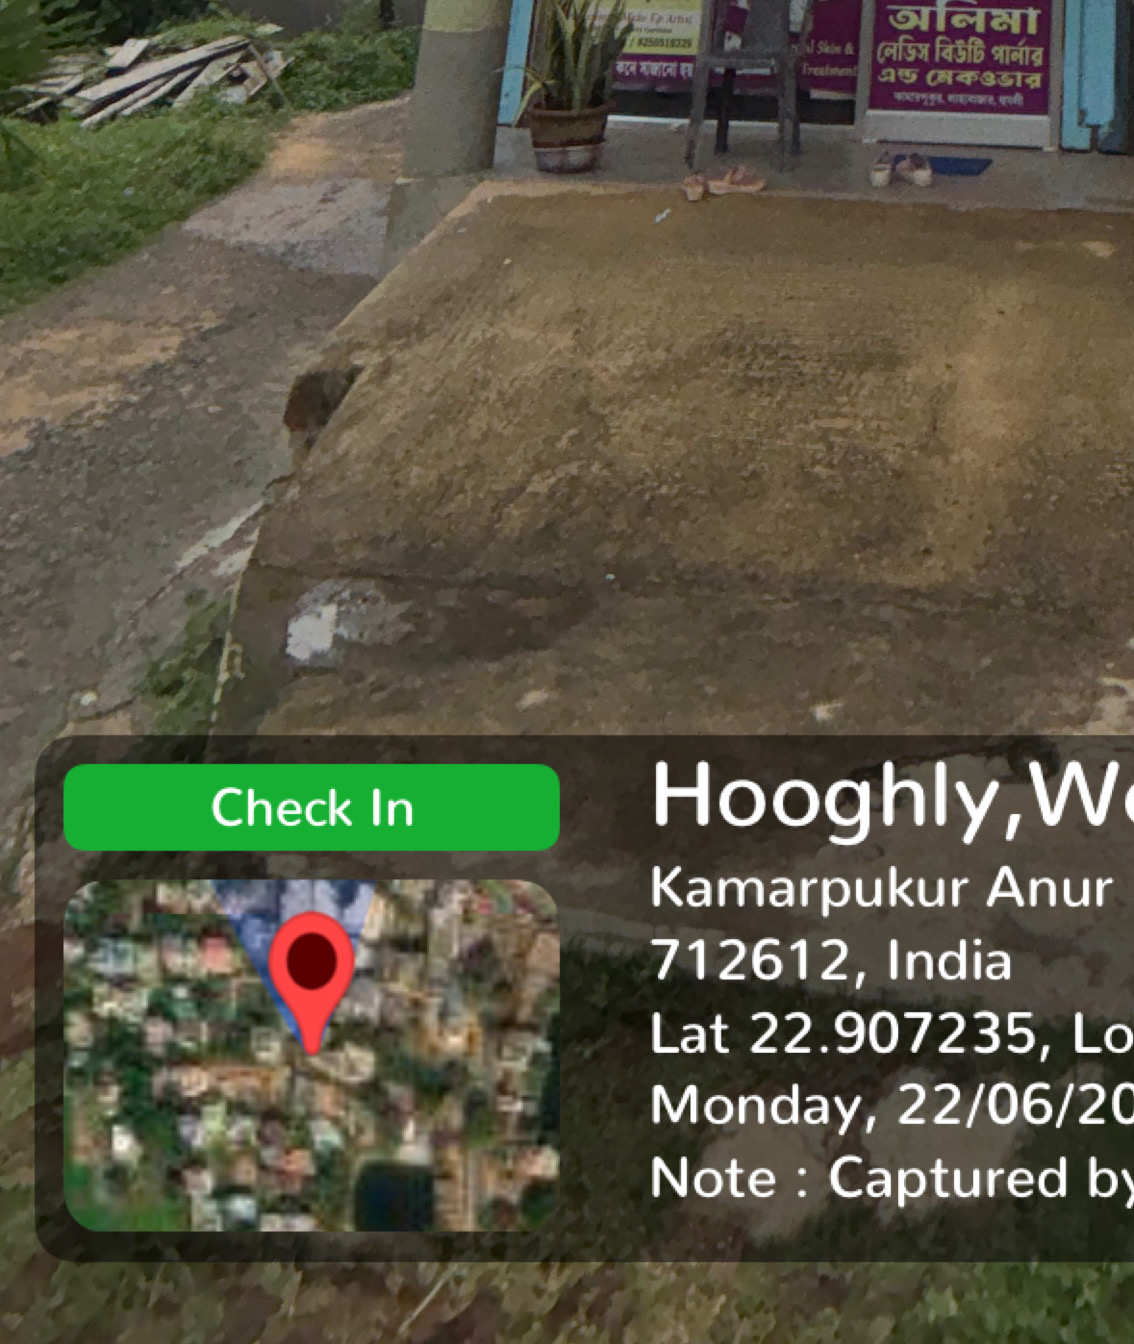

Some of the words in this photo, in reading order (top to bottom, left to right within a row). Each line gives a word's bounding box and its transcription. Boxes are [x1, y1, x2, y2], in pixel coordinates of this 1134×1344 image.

[817, 40, 842, 55] Skin
[844, 40, 855, 56] &
[877, 34, 931, 64] লেডিস
[935, 35, 985, 64] বিউটি
[803, 62, 859, 77] Treatment
[877, 67, 919, 84] এন্ড
[925, 68, 1043, 89] মেকওভার
